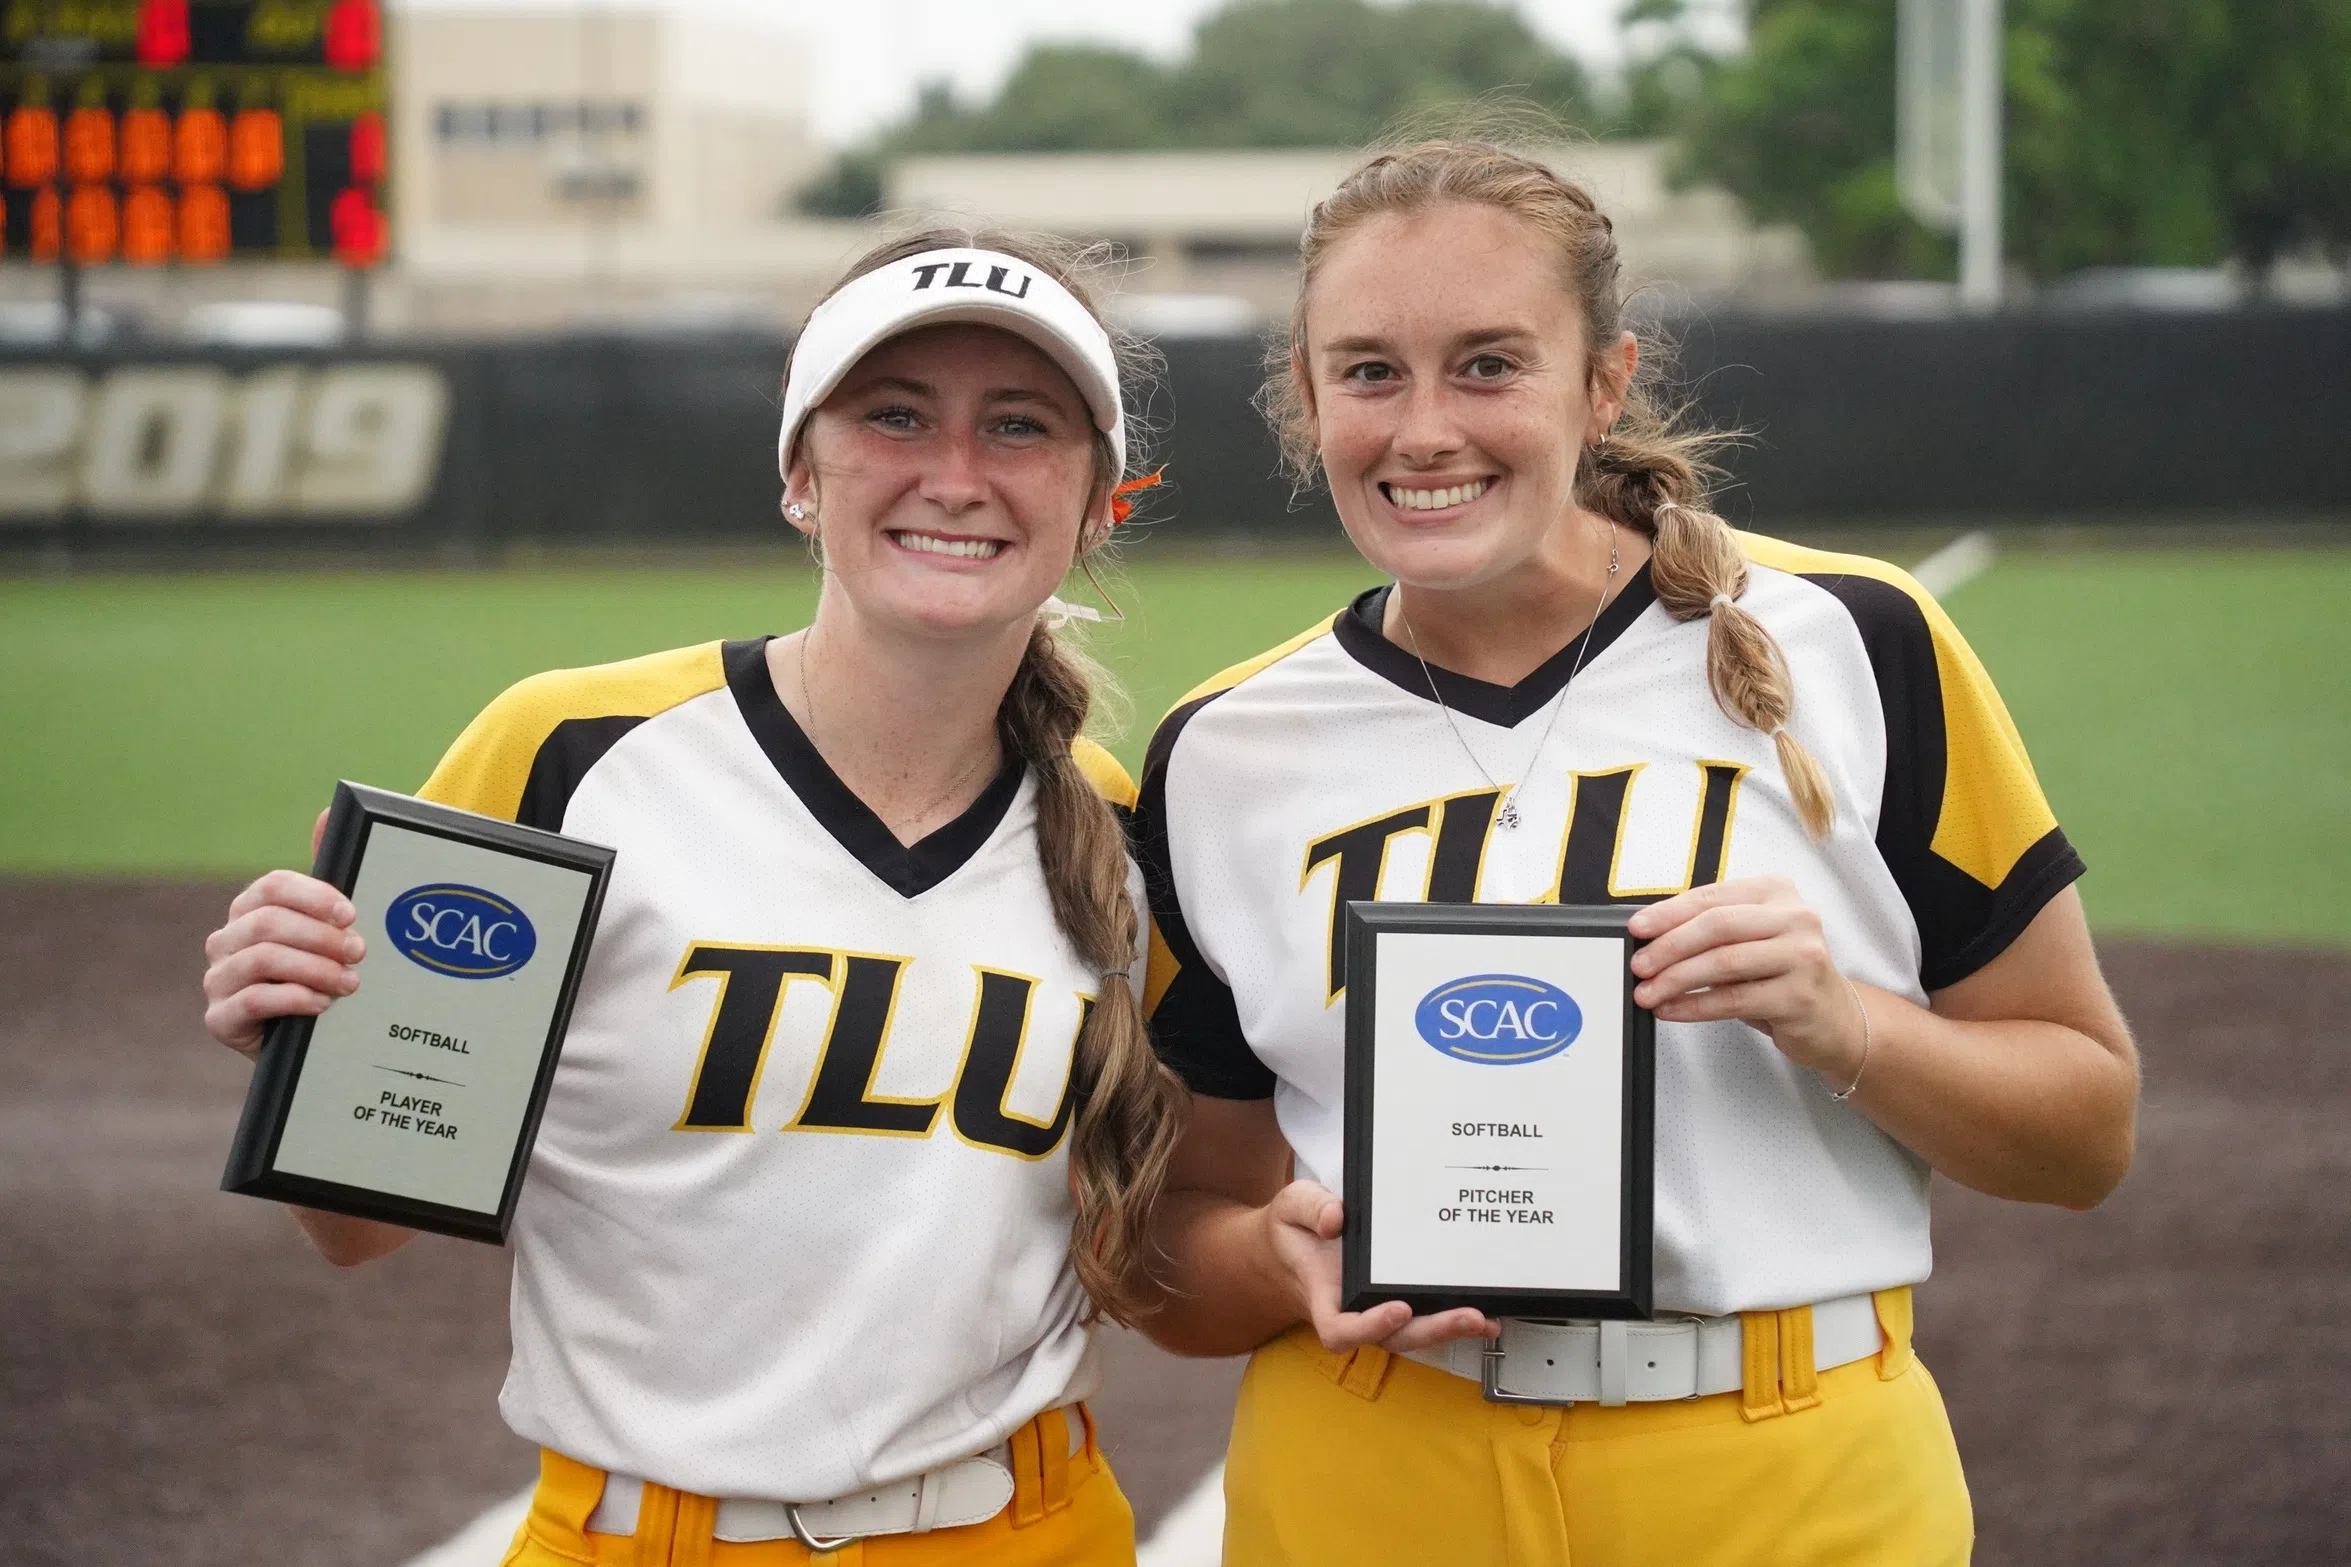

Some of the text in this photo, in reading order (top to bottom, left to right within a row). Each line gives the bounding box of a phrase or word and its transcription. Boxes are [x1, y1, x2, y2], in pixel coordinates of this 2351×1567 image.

[911, 262, 1032, 299] TLU
[405, 902, 517, 961] SCAC
[1439, 998, 1558, 1041] SCAC
[388, 1023, 470, 1055] SOFTBALL
[667, 940, 1097, 1161] TLU
[380, 1090, 443, 1117] PLAYER
[353, 1105, 458, 1140] OF THE YEAR
[1451, 1122, 1544, 1138] SOFTBALL
[1458, 1188, 1535, 1205] PITCHER
[1438, 1207, 1555, 1225] OF THE YEAR
